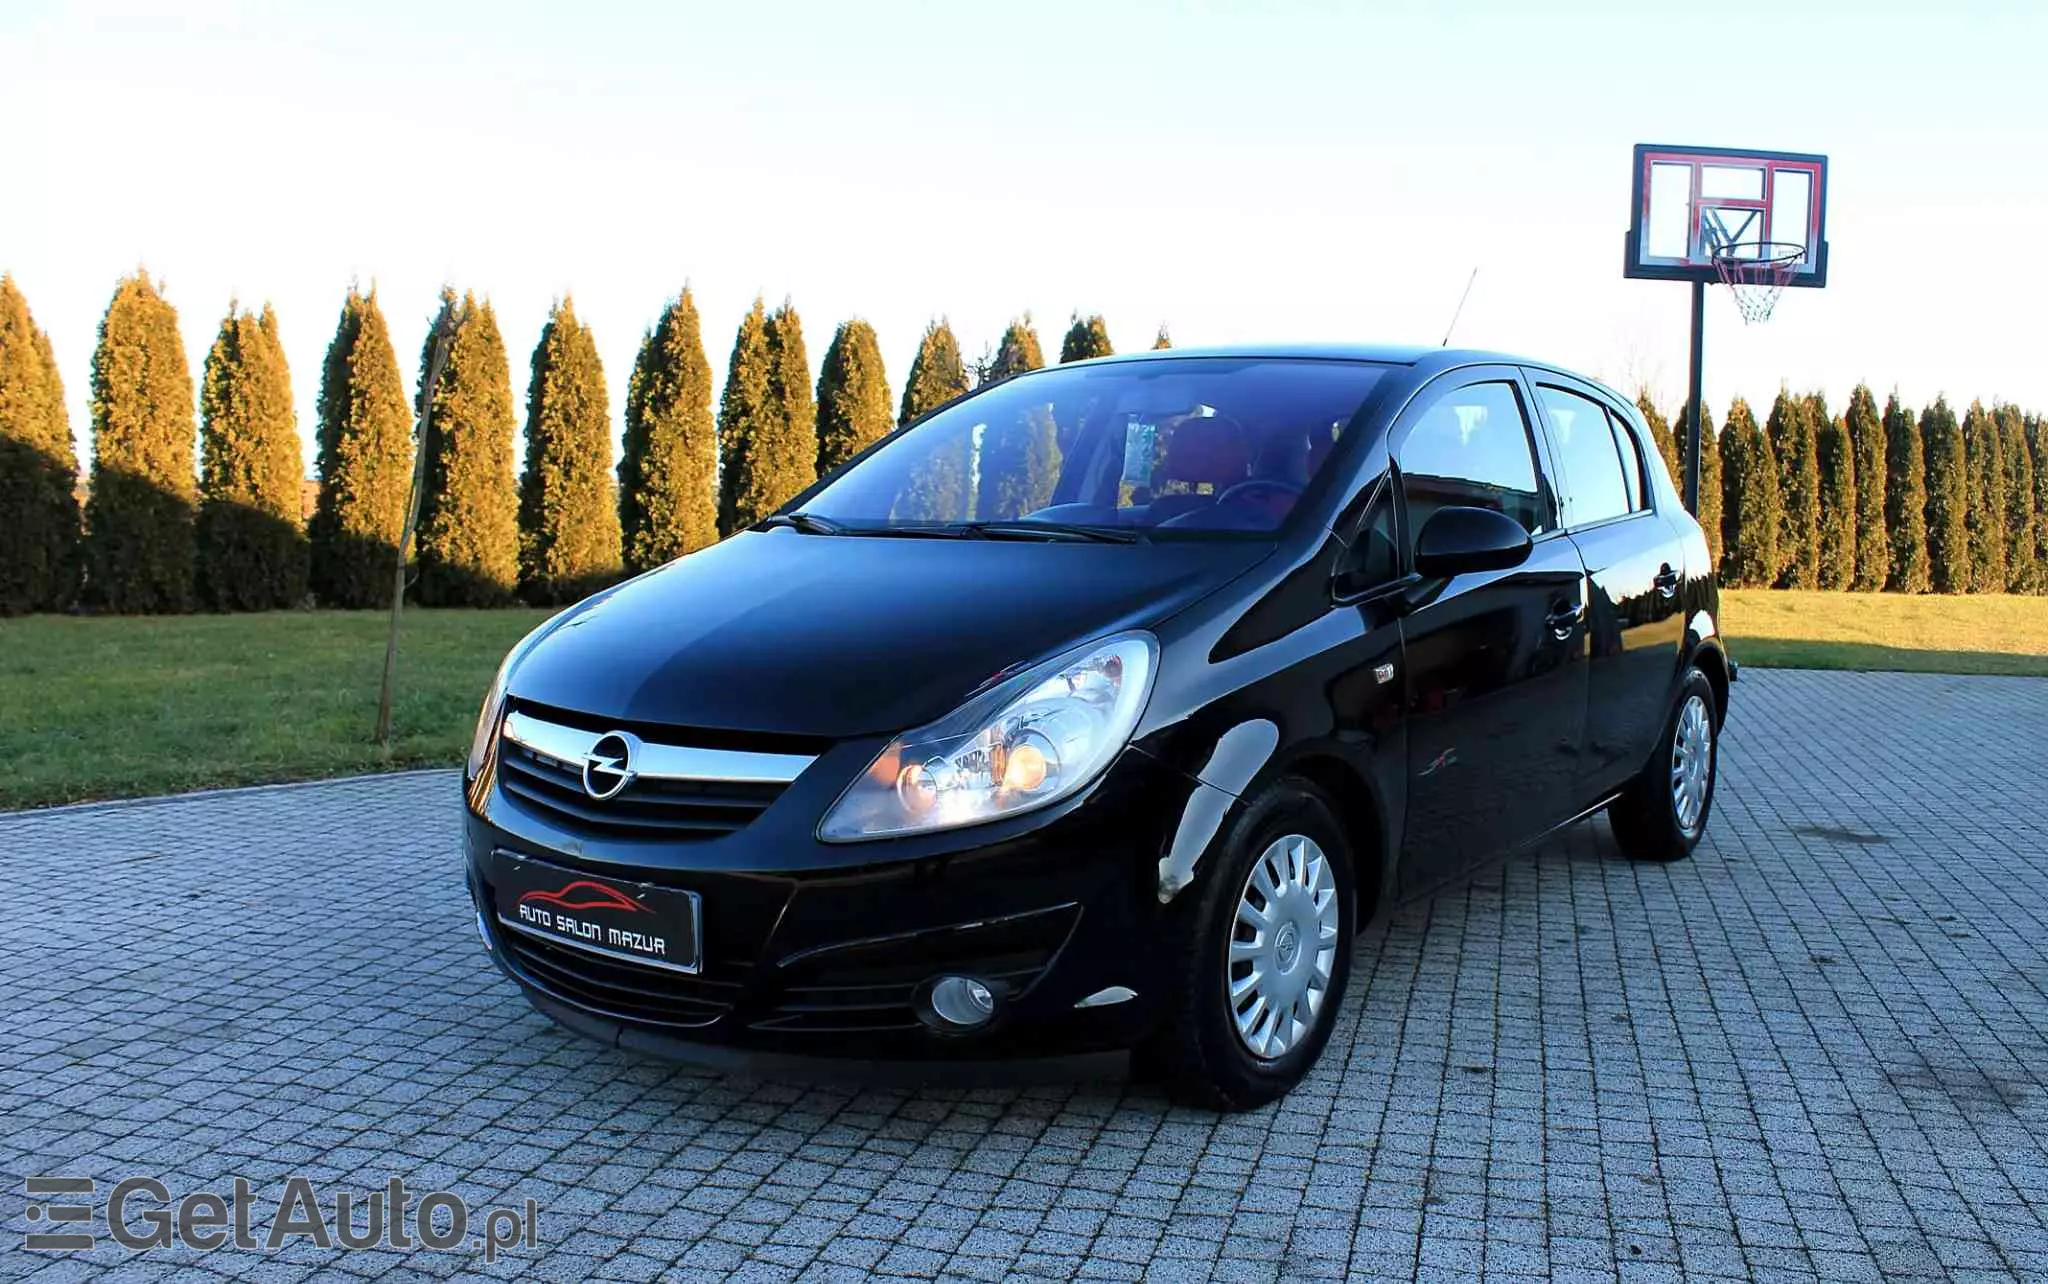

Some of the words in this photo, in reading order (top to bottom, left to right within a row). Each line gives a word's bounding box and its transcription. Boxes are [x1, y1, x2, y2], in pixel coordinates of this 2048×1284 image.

[519, 904, 551, 926] AUTO
[557, 915, 601, 941] SALON
[608, 928, 664, 954] MAZUR
